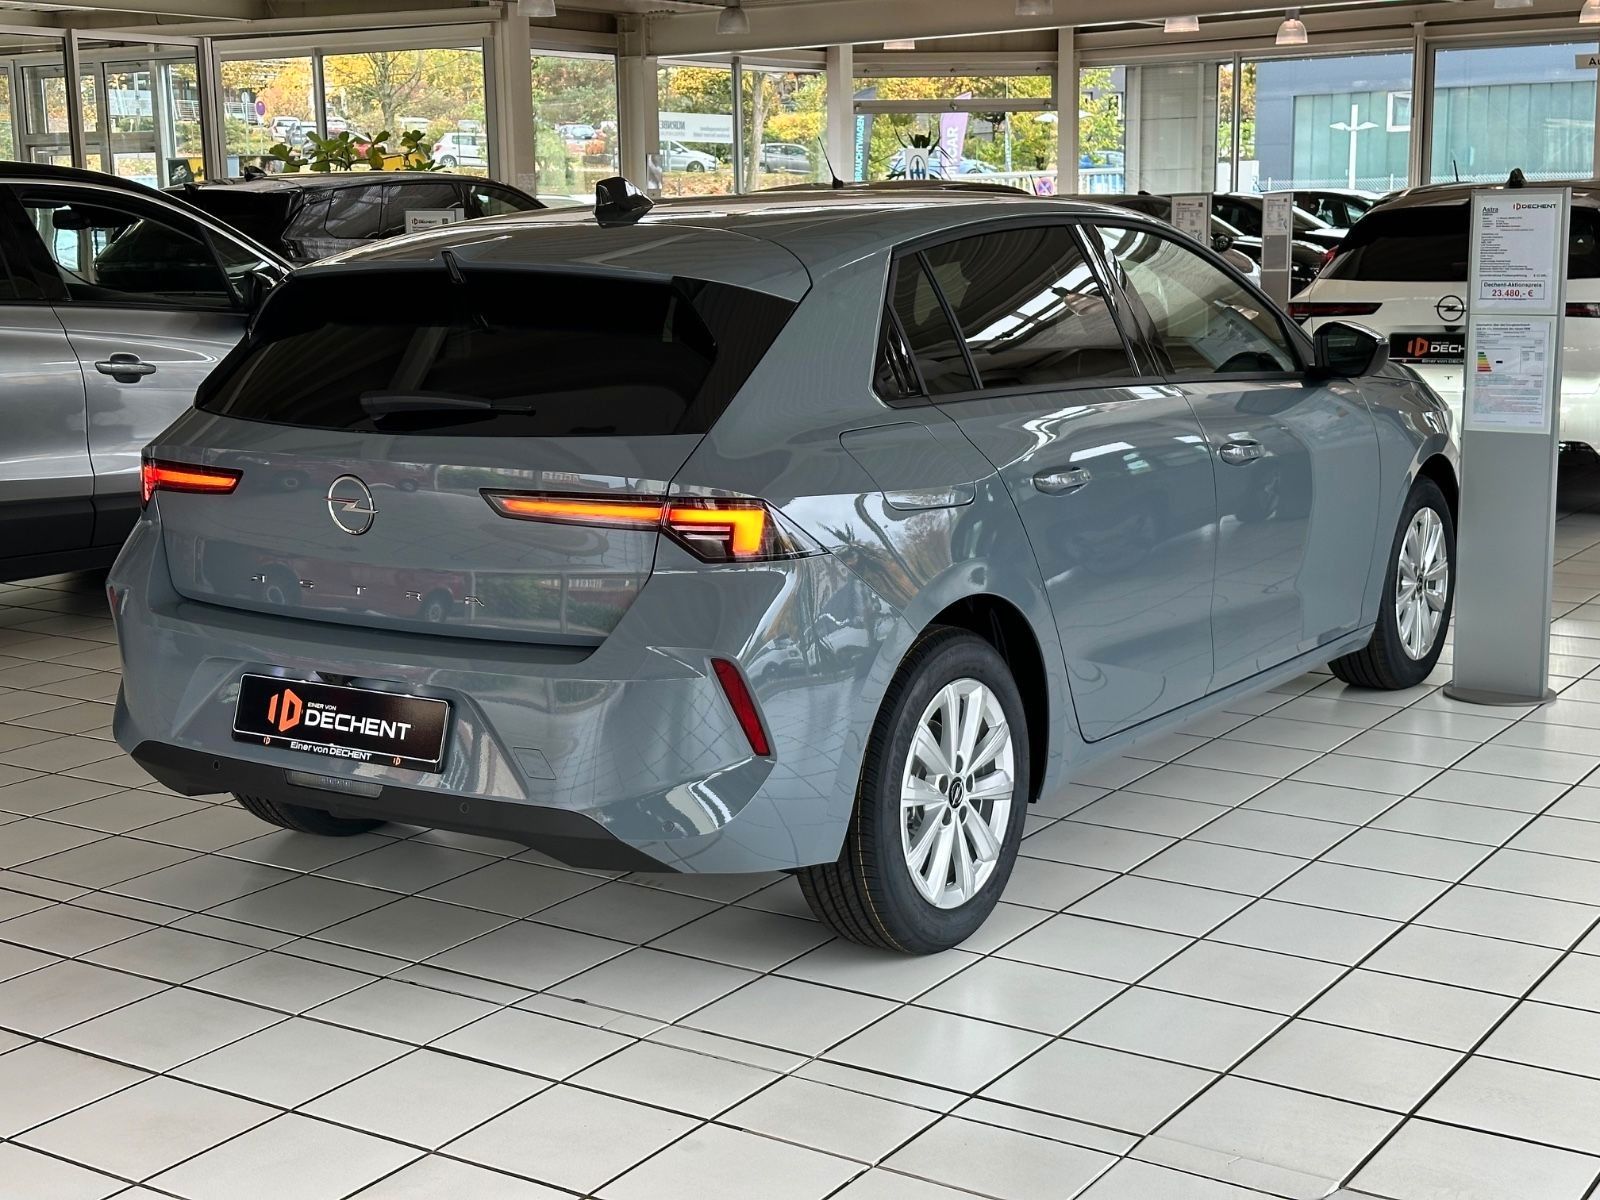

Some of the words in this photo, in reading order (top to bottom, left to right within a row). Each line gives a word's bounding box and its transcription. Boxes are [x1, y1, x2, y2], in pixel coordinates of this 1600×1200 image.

[251, 574, 485, 608] ASTRA
[307, 701, 324, 709] EINER
[304, 709, 411, 741] DECHENT
[290, 741, 312, 752] Einer
[312, 745, 329, 754] von
[329, 747, 372, 761] DECHENT
